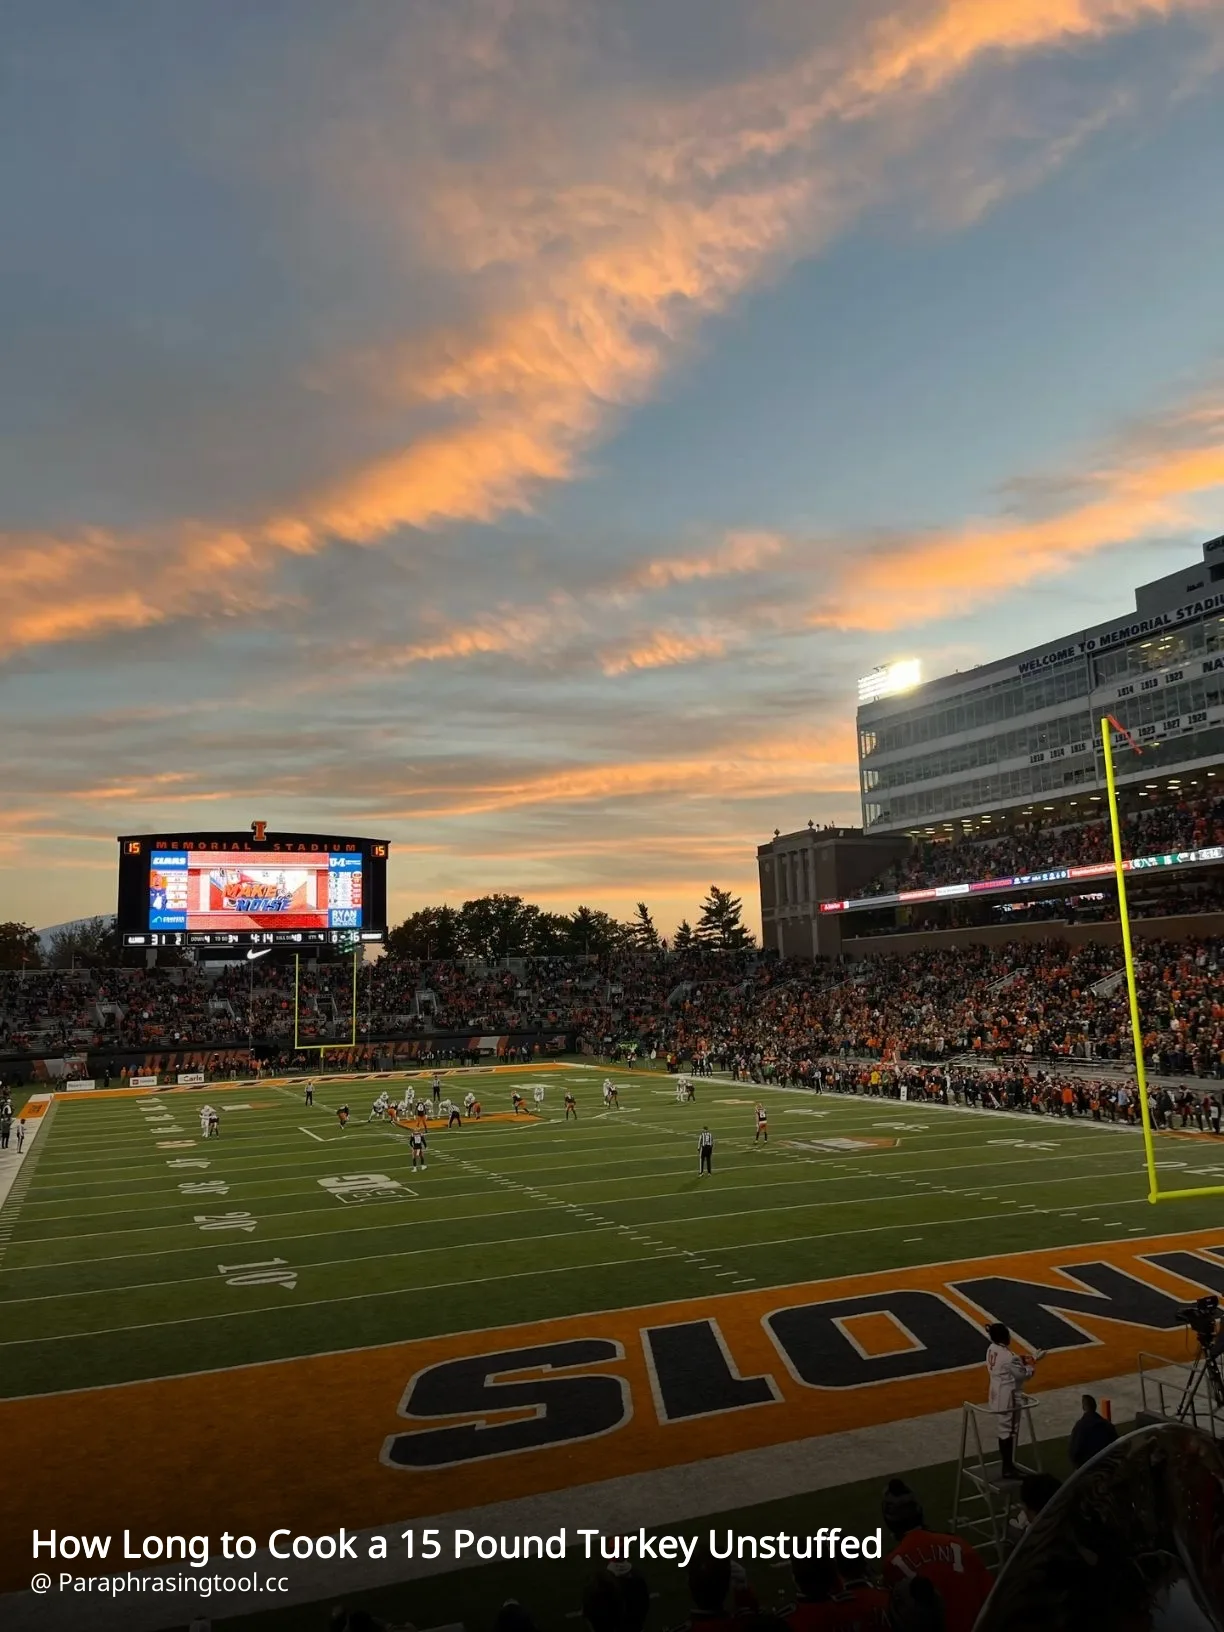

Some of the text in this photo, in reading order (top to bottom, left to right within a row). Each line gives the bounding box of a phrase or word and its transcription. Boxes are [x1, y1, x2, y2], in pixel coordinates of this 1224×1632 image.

[1018, 647, 1075, 674] WELCOME
[1078, 639, 1096, 652] TO
[1100, 613, 1172, 647] MEMORIAL
[1202, 656, 1224, 673] NA
[128, 842, 140, 854] 15
[156, 841, 356, 852] MEMORIAL STADIUM
[375, 846, 385, 857] 15
[222, 883, 278, 898] MAKE
[235, 896, 292, 912] NOISE
[250, 933, 274, 944] 4:14
[193, 1211, 259, 1232] 20
[217, 1257, 299, 1287] 10
[890, 1541, 965, 1578] ILLINI
